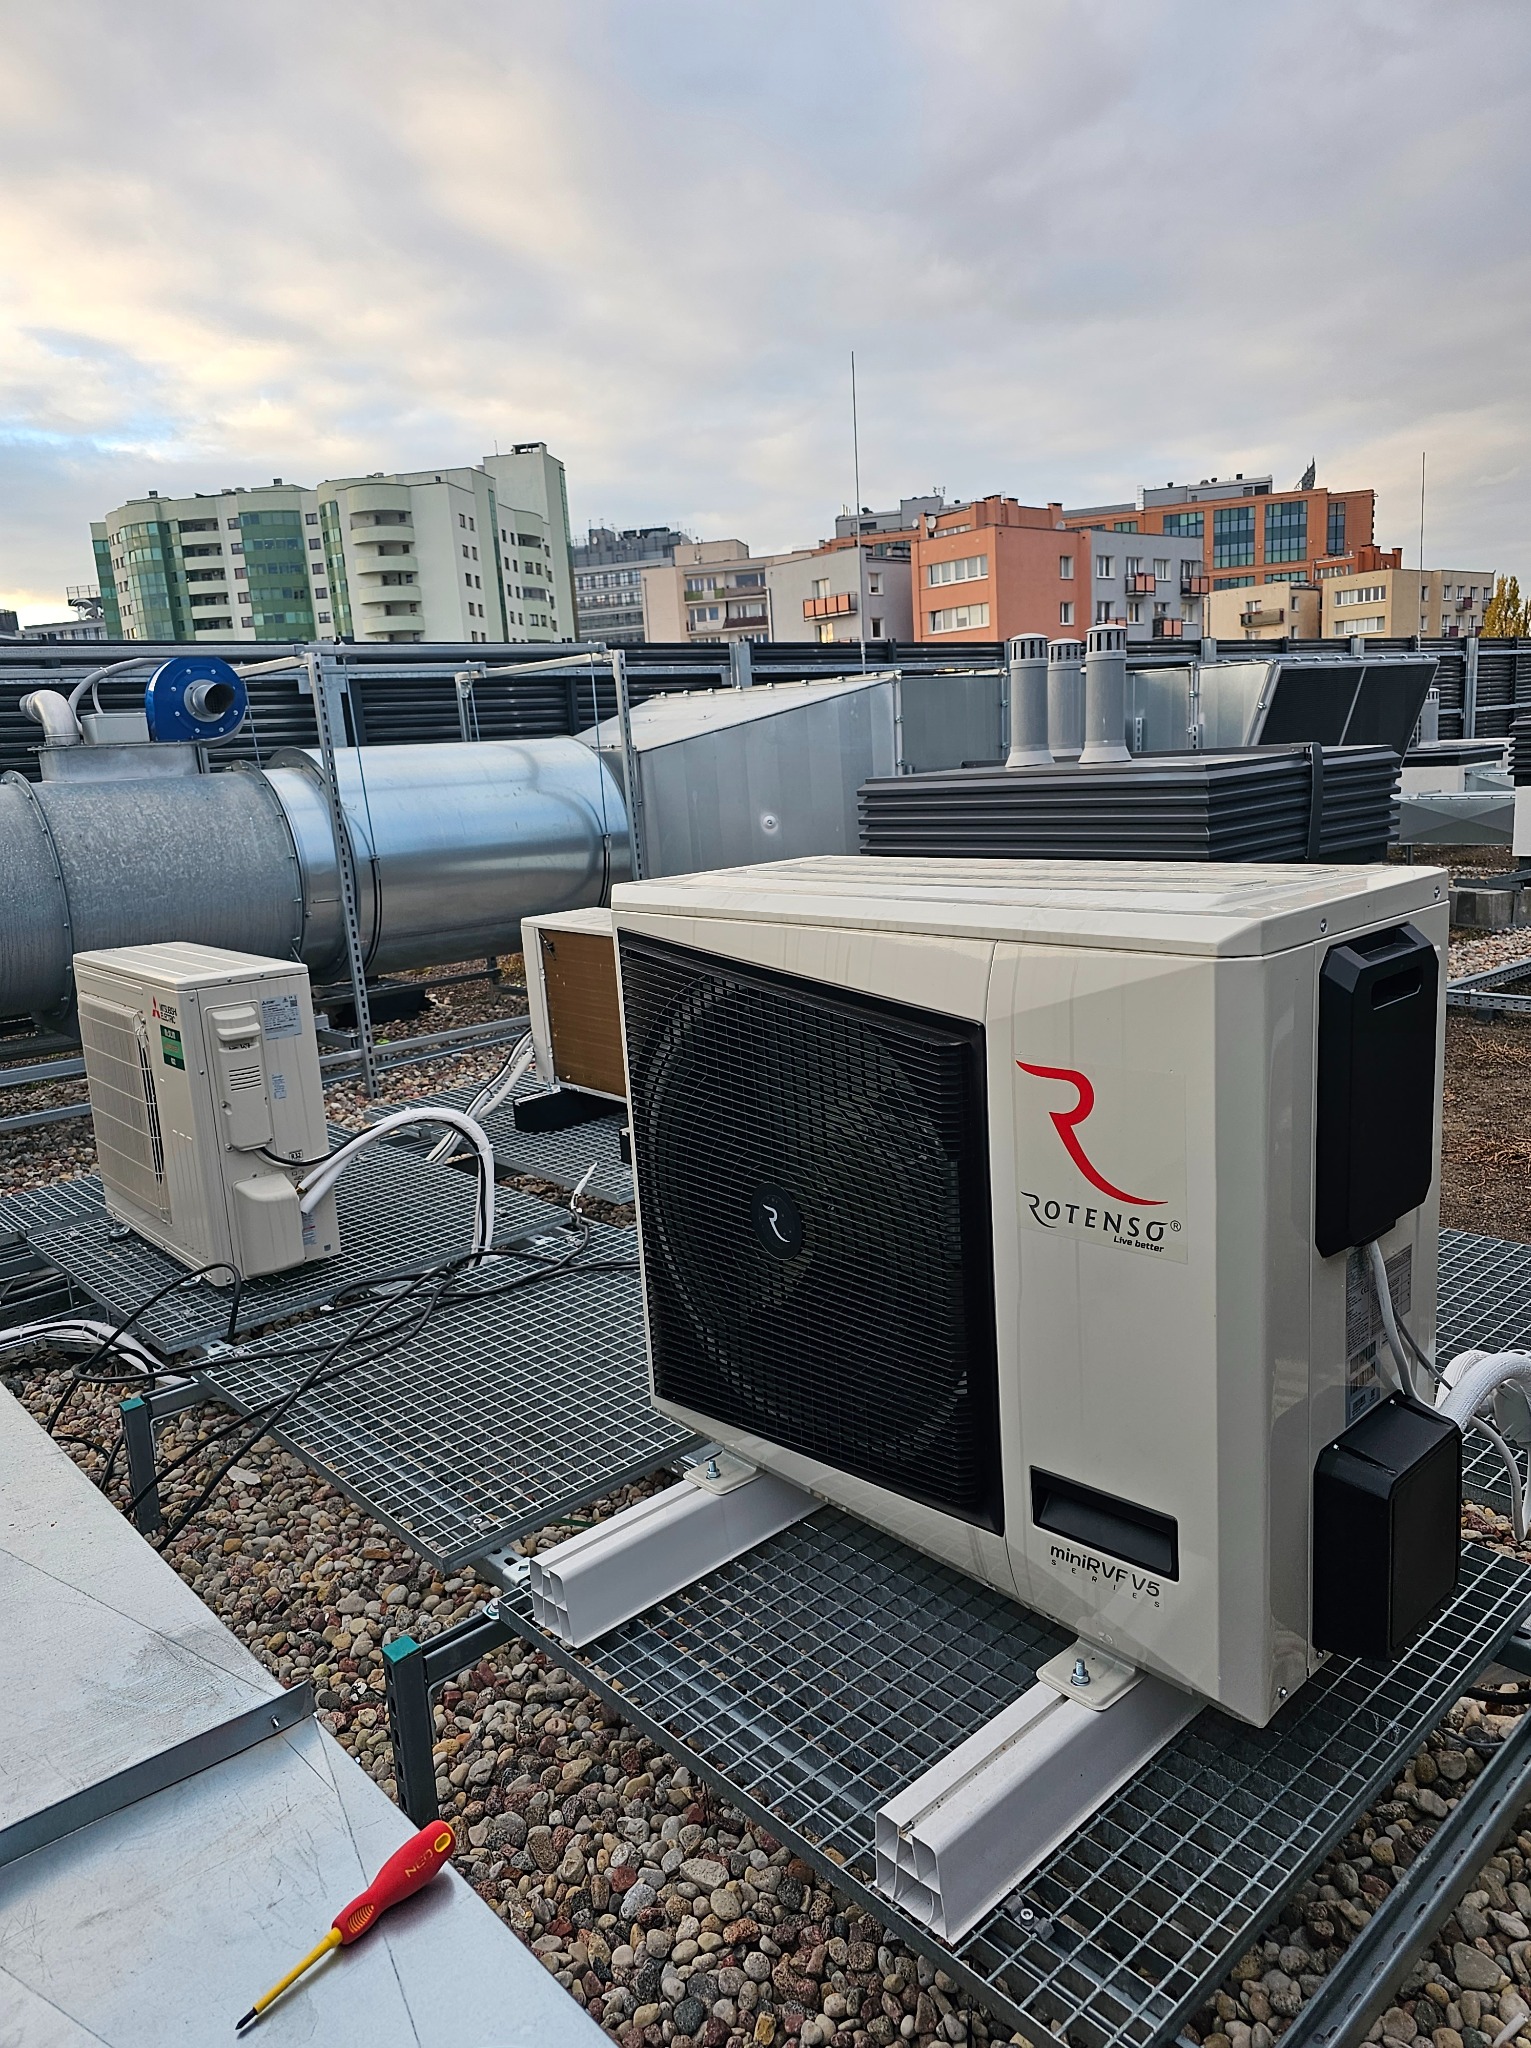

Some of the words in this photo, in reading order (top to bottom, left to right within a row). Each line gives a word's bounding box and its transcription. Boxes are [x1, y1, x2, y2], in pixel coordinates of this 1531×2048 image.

[1113, 1235, 1133, 1247] Live
[1134, 1239, 1165, 1253] better
[1050, 1545, 1129, 1583] miniRVF
[1131, 1573, 1161, 1598] V5
[1051, 1559, 1160, 1608] SERIES
